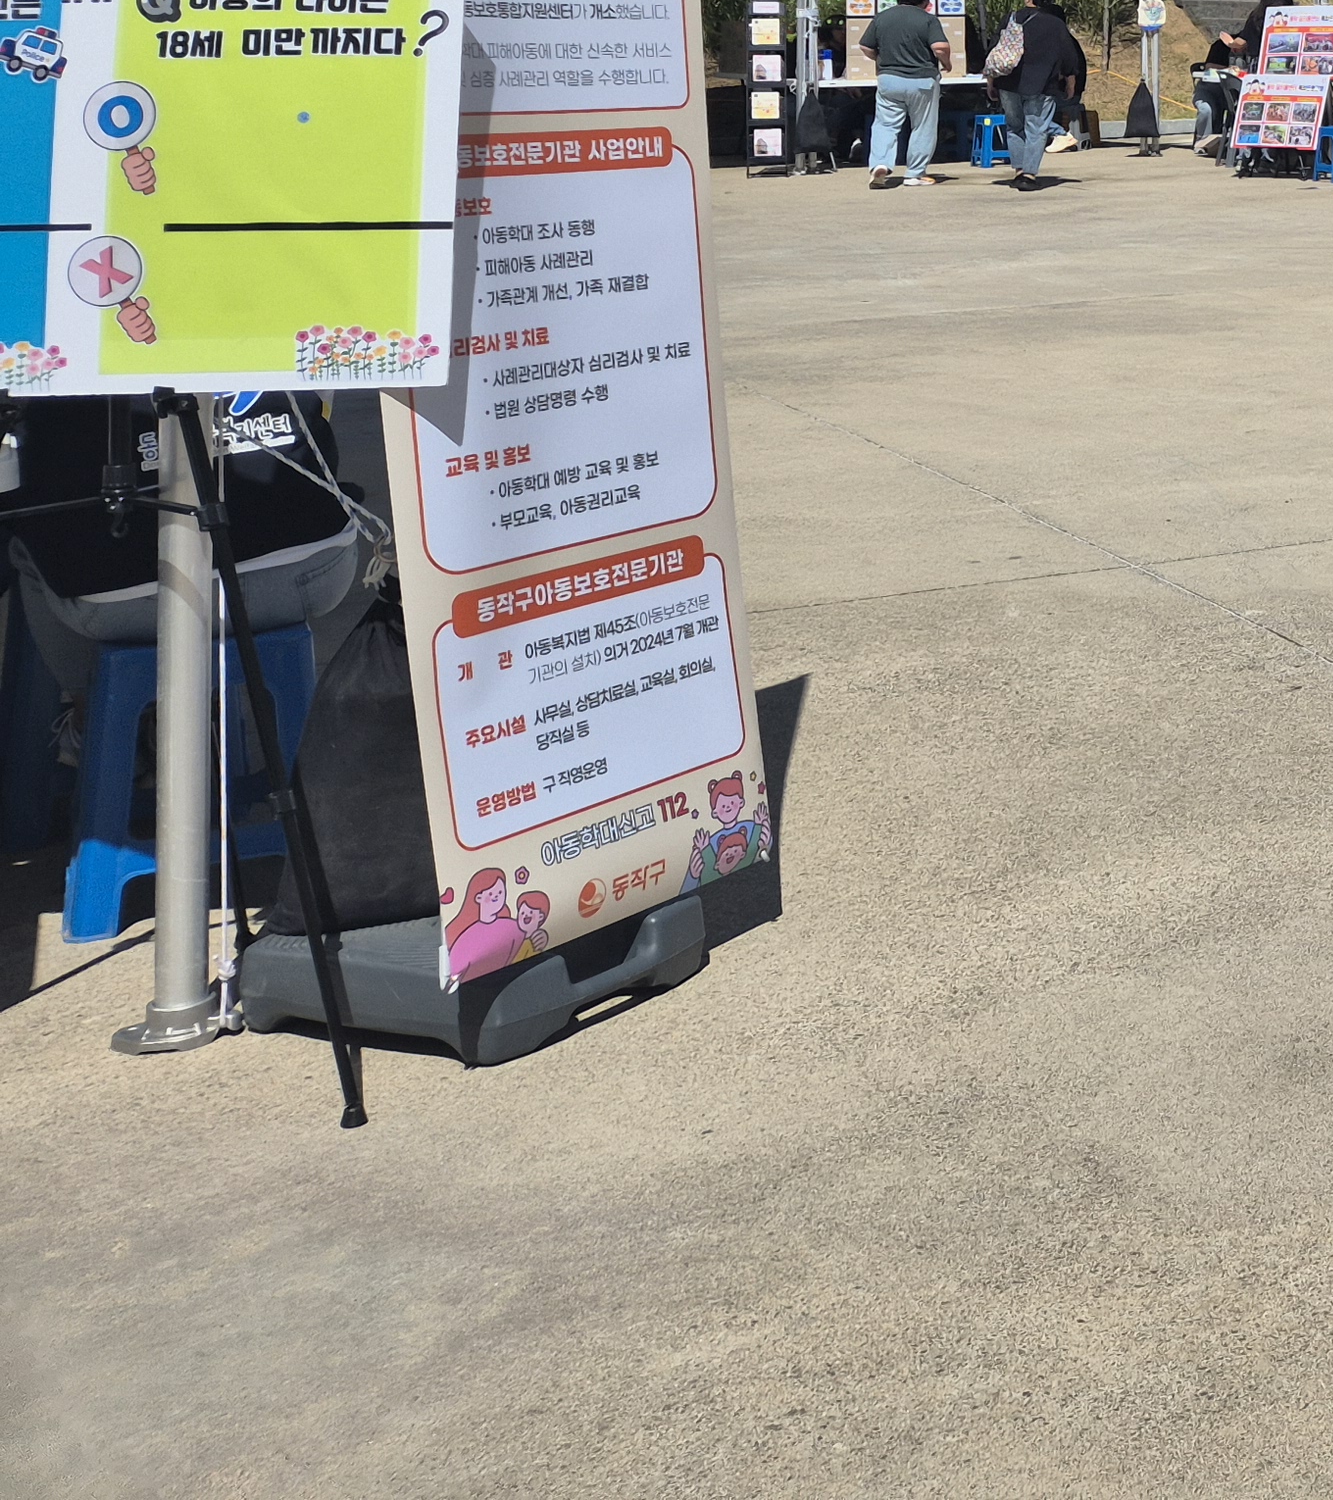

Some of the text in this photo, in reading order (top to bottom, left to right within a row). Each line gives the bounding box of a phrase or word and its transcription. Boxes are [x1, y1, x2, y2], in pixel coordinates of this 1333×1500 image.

[590, 3, 670, 20] 개소했습니다.
[20, 48, 46, 63] Police
[156, 30, 223, 59] 18세
[487, 43, 672, 60] 피해아동에 대한 신속한 서비스
[498, 71, 550, 88] 사례관리
[552, 69, 593, 87] 역할을
[598, 69, 669, 86] 수행합니다.
[588, 136, 664, 162] 사업안내
[482, 219, 596, 245] 아동학대 조사 동행
[484, 249, 594, 277] 피해아동 사례관리
[486, 273, 650, 308] 가족관계 개선, 가족 재결합
[504, 326, 550, 350] 및 치료
[492, 341, 692, 388] 사례관리대상자 심리검사 및 치료
[494, 383, 610, 420] 법원 상담명령 수행
[445, 443, 531, 478] 교육 및 홍보
[498, 450, 660, 498] 아동학대 예방 교육 및 홍보
[499, 484, 641, 530] 부모교육, 아동권리교육
[477, 548, 684, 624] 동작구아동보호전문기관
[524, 627, 591, 660] 아동복지법
[528, 615, 720, 685] 기관의 의거 2024년 7월 개관
[465, 714, 526, 749] 주요시설
[536, 719, 590, 751] 당직실 등
[476, 757, 609, 818] 운영방법 구 직영운영
[541, 791, 690, 866] 아동학대신고 112
[612, 858, 666, 902] 동작구
